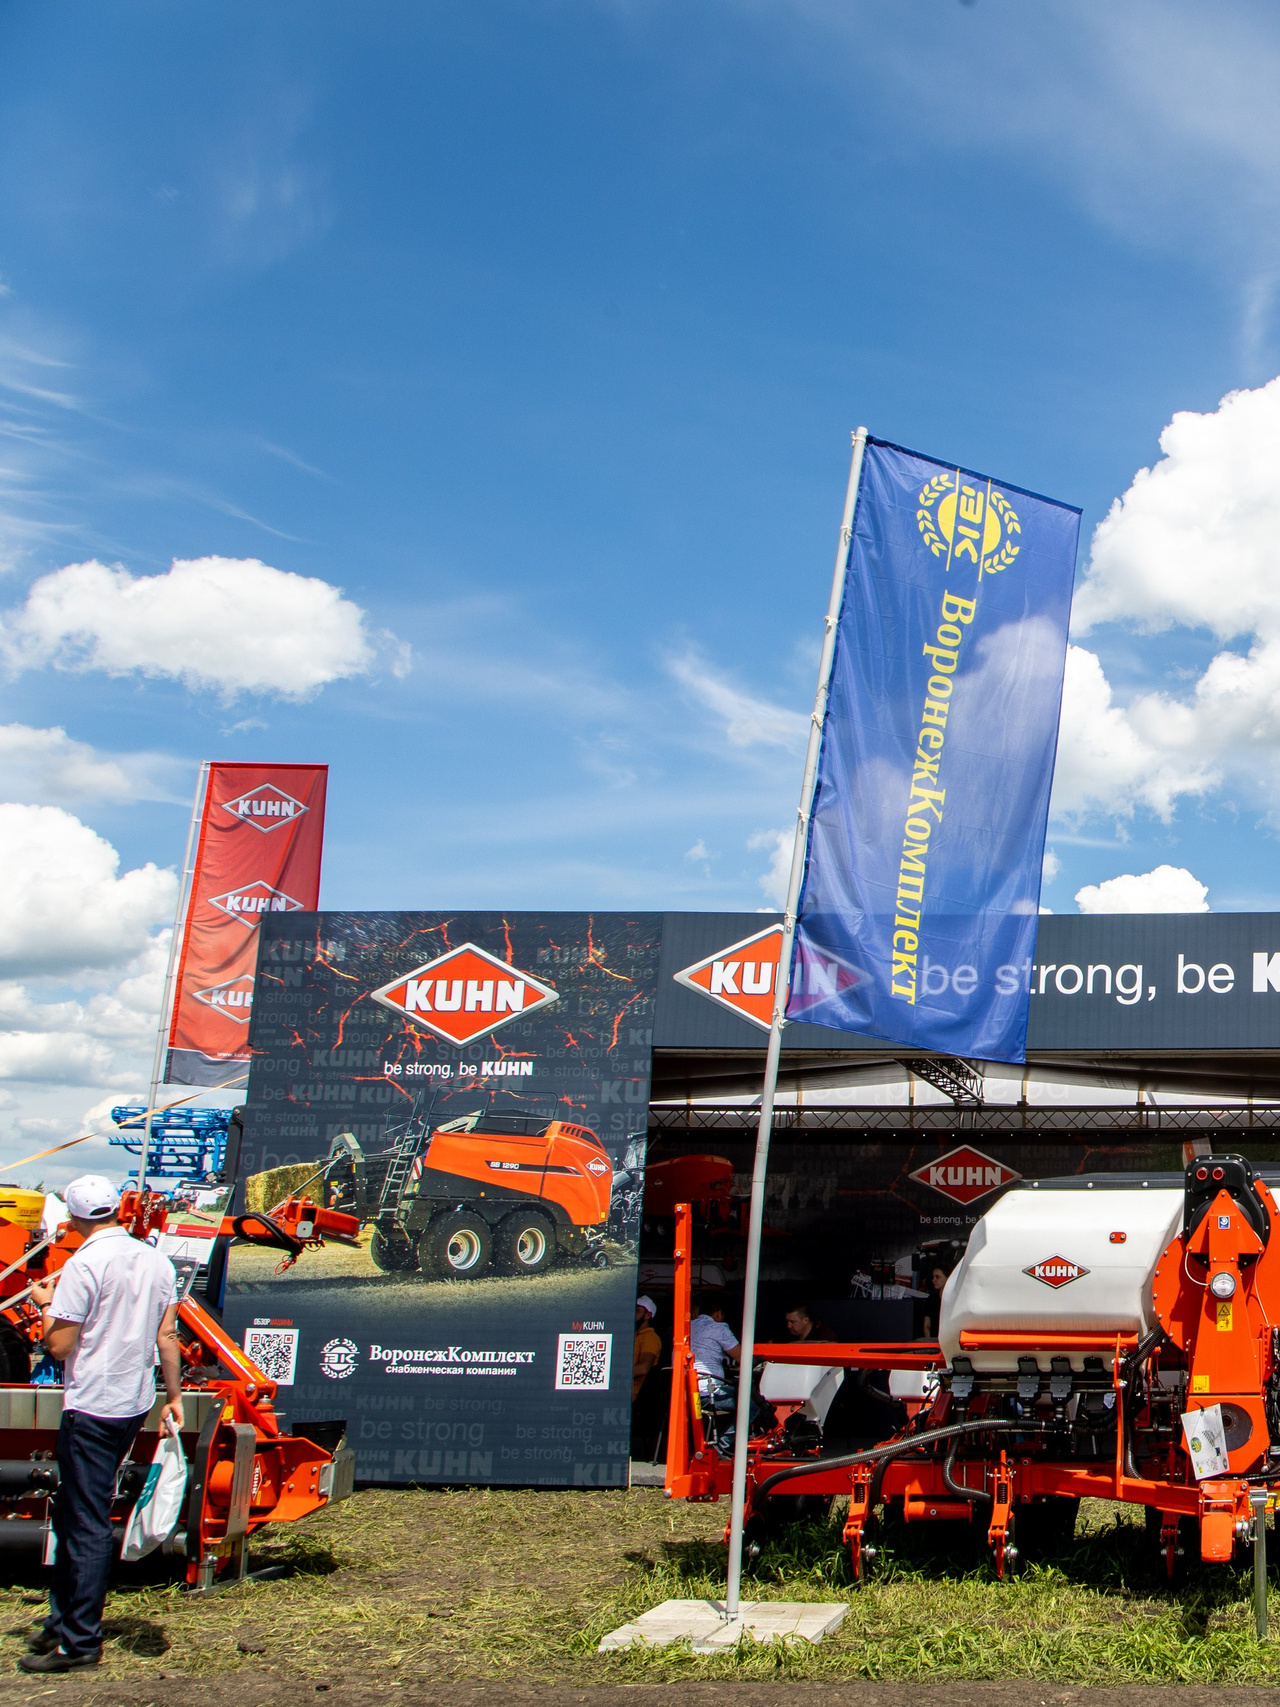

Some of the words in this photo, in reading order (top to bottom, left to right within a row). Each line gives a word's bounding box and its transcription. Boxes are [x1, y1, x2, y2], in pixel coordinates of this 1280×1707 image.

[890, 588, 977, 1006] ВоронежКомплект
[238, 799, 295, 817] KUHN
[226, 895, 286, 912] KUHN
[921, 955, 978, 995] be
[995, 956, 1156, 1004] strong,
[1177, 954, 1235, 994] be
[211, 990, 253, 1008] KUH
[405, 979, 525, 1013] KUHN
[251, 1055, 300, 1076] trong
[313, 1050, 381, 1067] KUHN
[384, 1062, 402, 1075] be
[405, 1063, 454, 1079] strong,
[459, 1062, 478, 1075] be
[481, 1061, 534, 1076] KUHN
[291, 1084, 357, 1102] KUHN
[929, 1166, 1002, 1187] KUHN
[919, 1215, 932, 1224] be
[933, 1216, 963, 1226] strong,
[965, 1215, 977, 1224] be
[1035, 1265, 1078, 1277] KUHN
[369, 1344, 535, 1365] ВоронежКомплект
[385, 1364, 464, 1375] снабженческая
[466, 1365, 517, 1376] компания
[356, 1395, 415, 1410] KUHN
[360, 1415, 392, 1439] be
[401, 1417, 485, 1447] strong
[516, 1424, 536, 1439] be
[541, 1425, 593, 1442] strong
[356, 1449, 389, 1462] UHN
[394, 1449, 494, 1476] KUHN
[573, 1463, 628, 1486] KU
